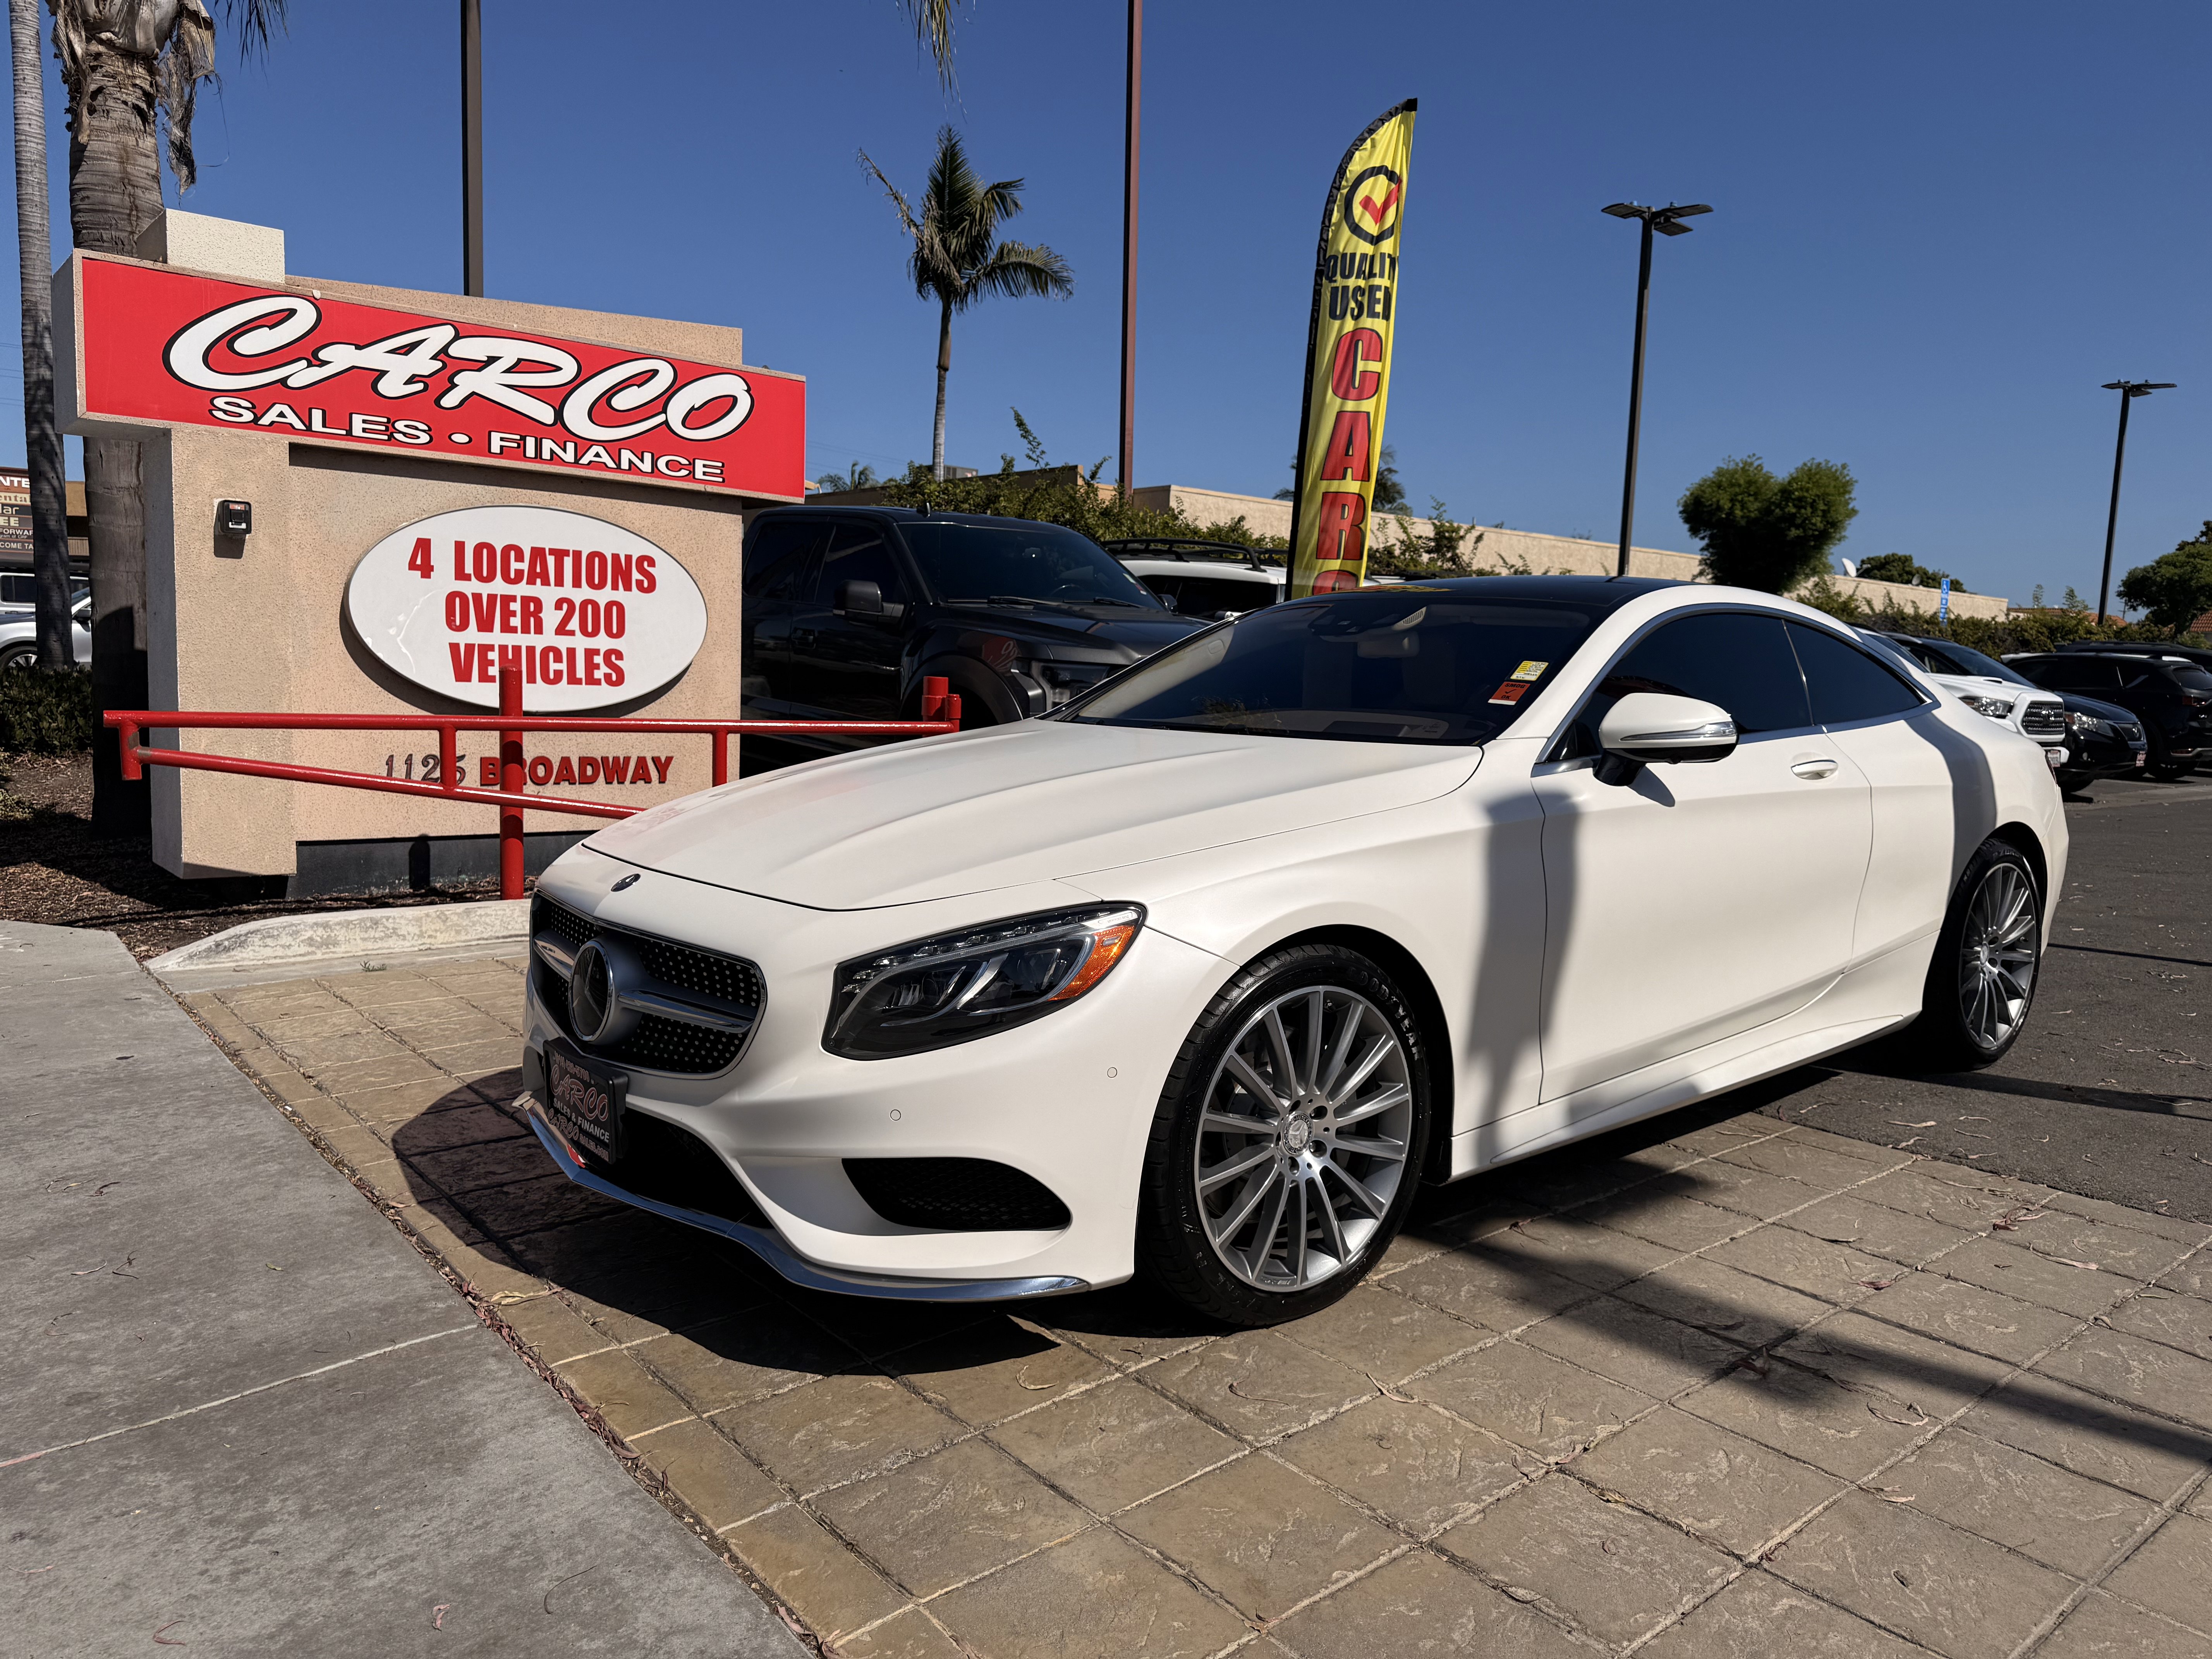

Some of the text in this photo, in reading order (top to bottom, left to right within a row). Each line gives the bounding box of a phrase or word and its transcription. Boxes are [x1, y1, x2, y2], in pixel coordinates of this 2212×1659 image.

[162, 295, 754, 442] CARCO
[209, 395, 725, 483] SALES FINANCE
[408, 538, 657, 594] 4 LOCATIONS
[445, 591, 626, 639] OVER 200
[448, 642, 625, 687] VEHICLES
[480, 756, 674, 786] BOADWAY
[550, 1064, 609, 1121] CARCO
[547, 1108, 580, 1141] CARCO
[553, 1097, 610, 1143] SALES & FINANCE
